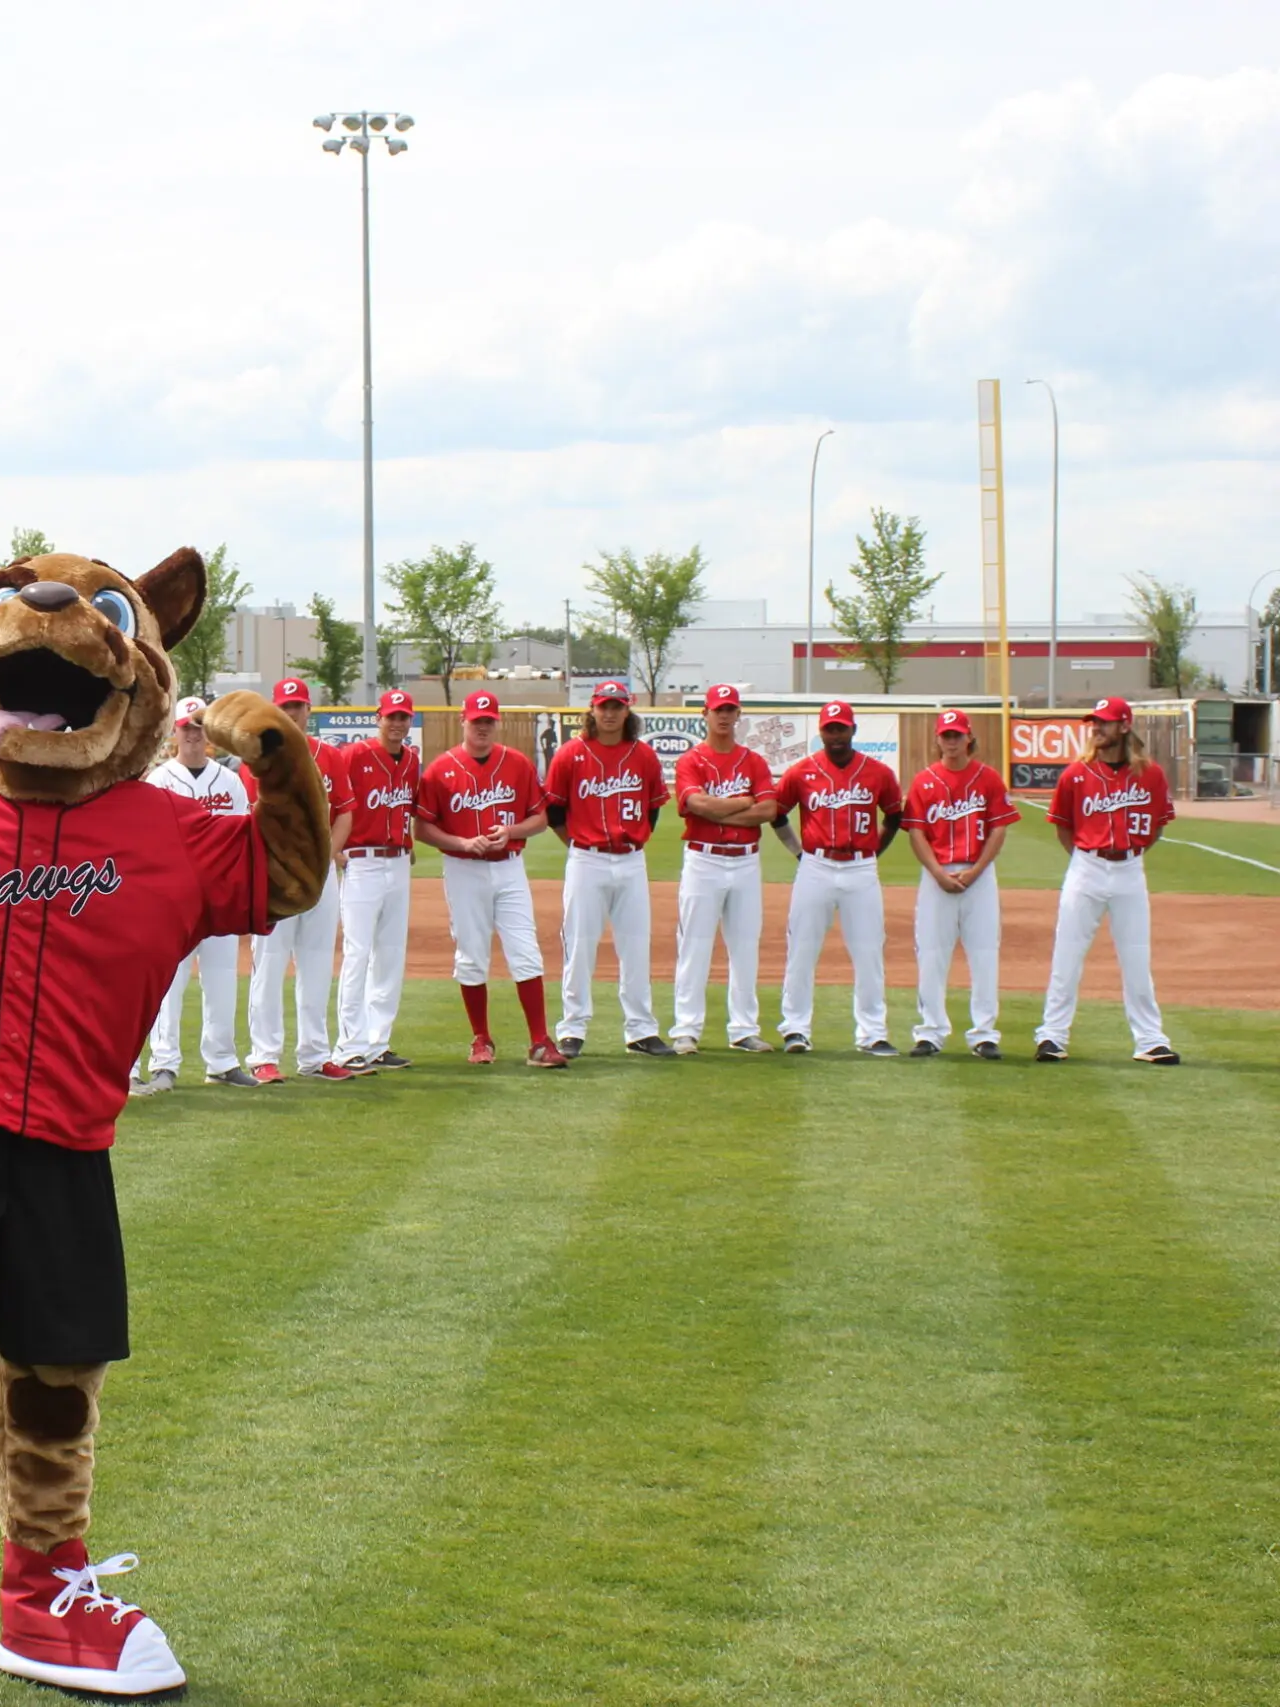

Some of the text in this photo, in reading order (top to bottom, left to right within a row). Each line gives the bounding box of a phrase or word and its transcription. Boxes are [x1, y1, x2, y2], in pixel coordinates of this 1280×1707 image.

[644, 716, 708, 740] KOTOKS
[652, 739, 690, 751] FORD
[1012, 724, 1094, 759] SIGN
[450, 780, 516, 813] Okotoks
[578, 768, 643, 799] Okotoks
[808, 782, 873, 811] Okotoks
[622, 798, 642, 822] 24
[927, 790, 987, 824] Okotoks
[1082, 782, 1152, 817] Okotoks
[854, 811, 870, 835] 12
[975, 819, 985, 841] 3
[1128, 812, 1152, 836] 33
